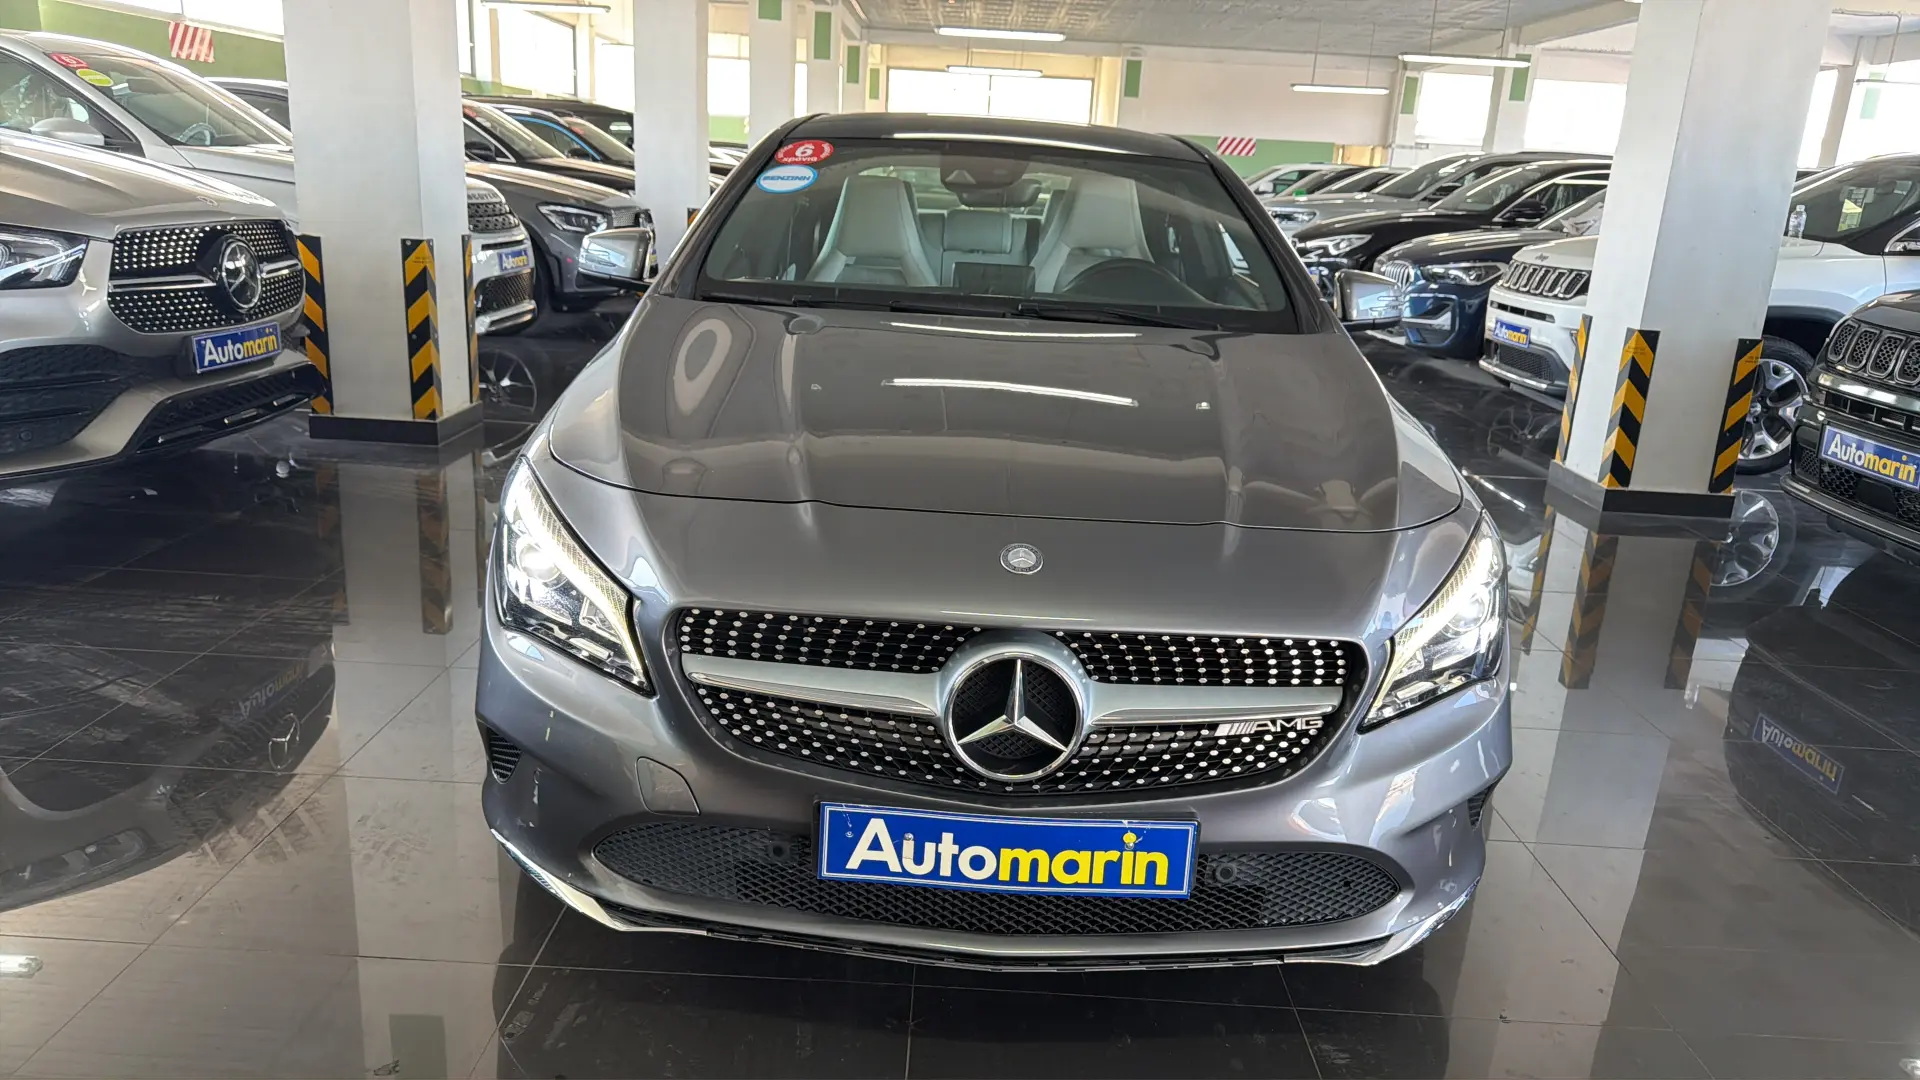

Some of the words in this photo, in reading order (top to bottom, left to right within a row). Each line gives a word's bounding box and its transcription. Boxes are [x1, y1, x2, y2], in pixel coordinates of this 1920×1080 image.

[795, 144, 815, 157] 6
[203, 327, 277, 367] Automarin
[1827, 433, 1916, 483] Automarin
[1252, 716, 1324, 732] AMG
[845, 817, 1169, 886] Automarin
